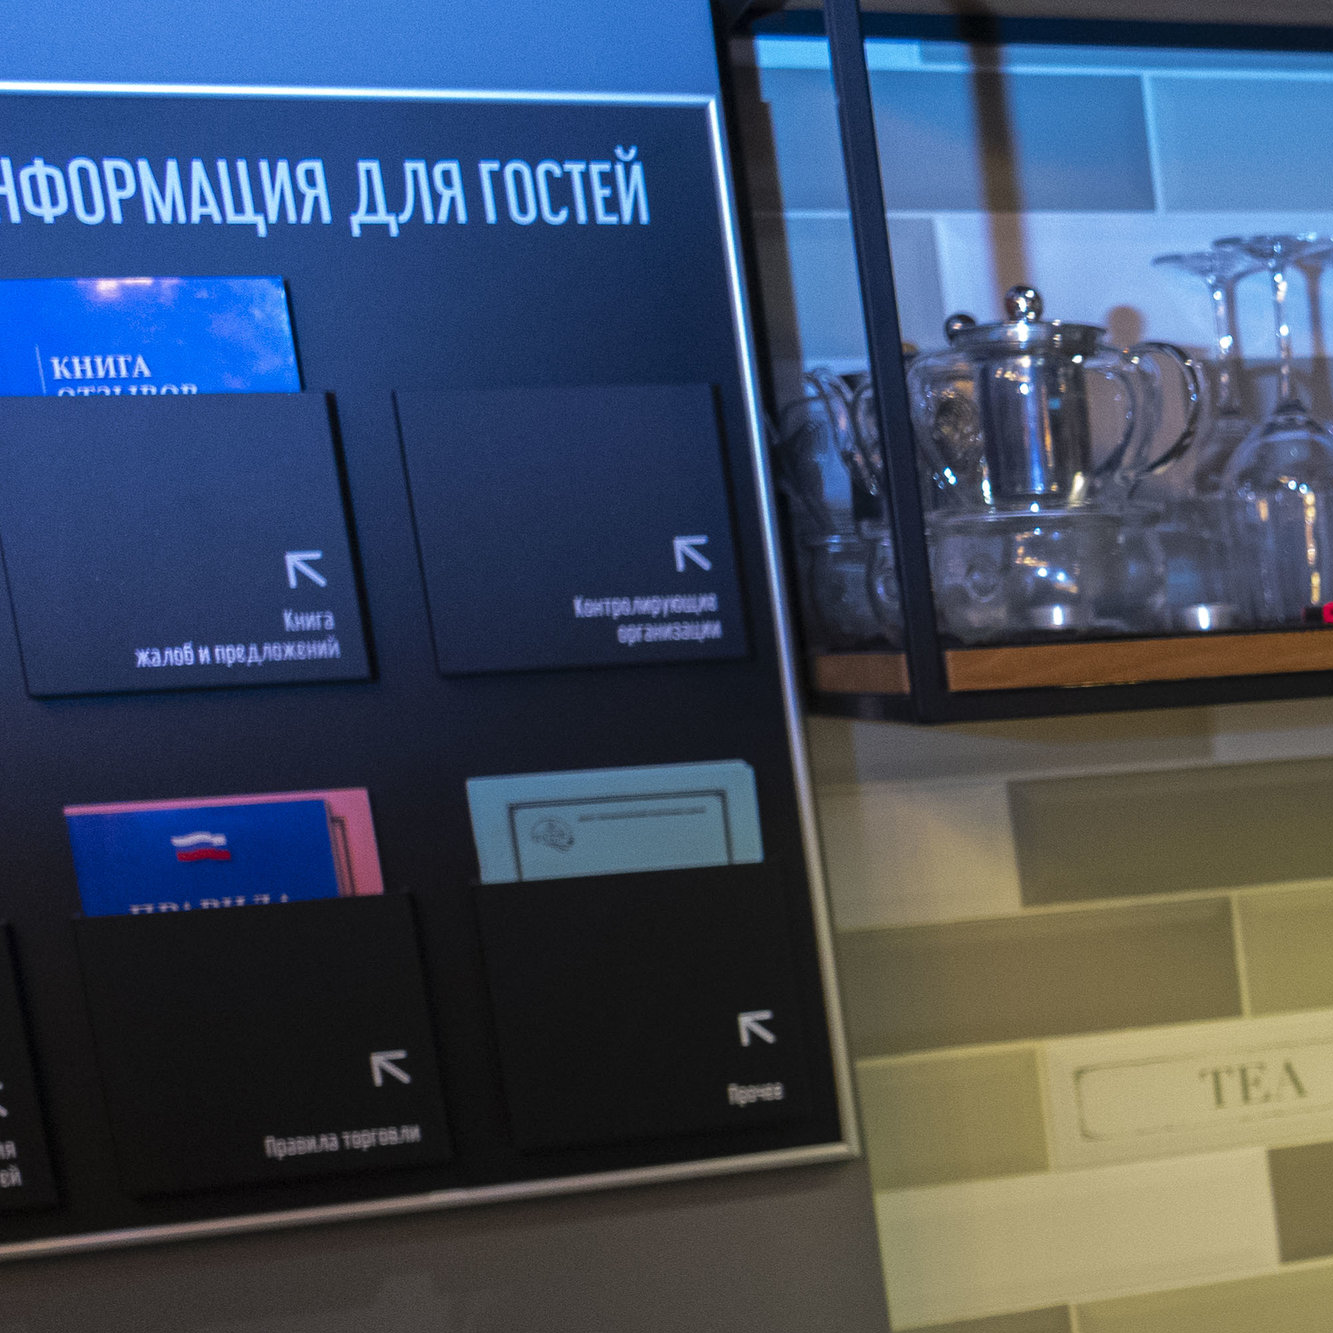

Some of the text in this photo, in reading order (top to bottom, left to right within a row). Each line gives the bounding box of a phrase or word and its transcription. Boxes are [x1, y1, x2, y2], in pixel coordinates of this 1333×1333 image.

[350, 158, 468, 237] ДЛЯ
[478, 146, 649, 225] ГОСТЕЙ
[51, 354, 151, 380] КНИГА
[282, 609, 335, 632] Книга
[134, 636, 341, 668] жалоб и предложений
[1200, 1060, 1308, 1108] TEA
